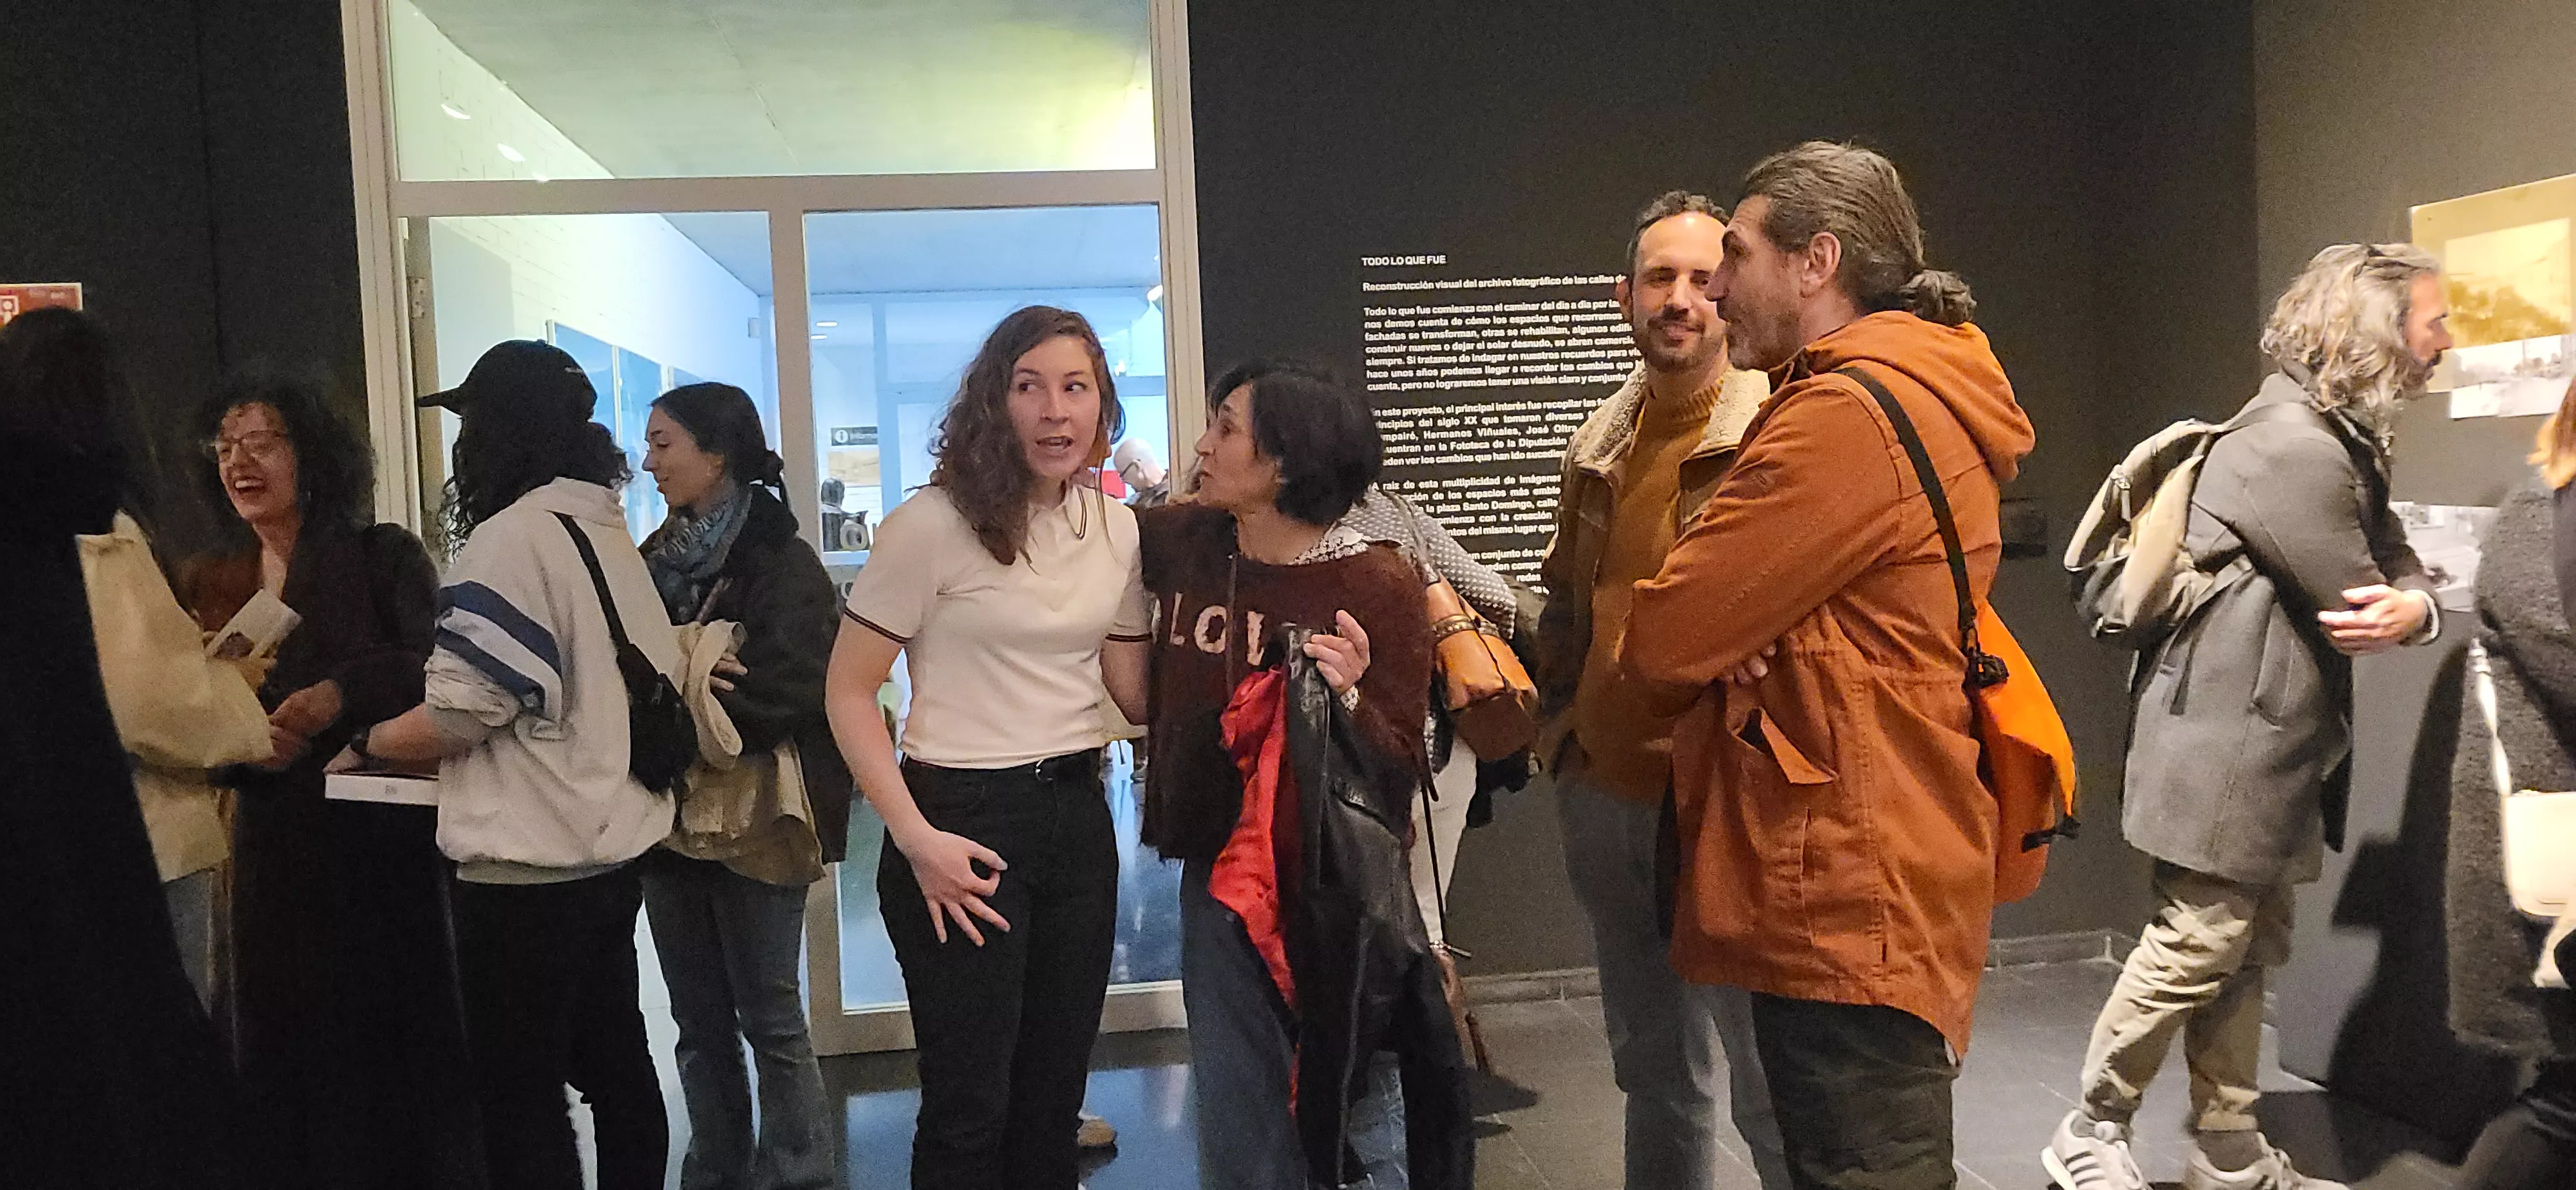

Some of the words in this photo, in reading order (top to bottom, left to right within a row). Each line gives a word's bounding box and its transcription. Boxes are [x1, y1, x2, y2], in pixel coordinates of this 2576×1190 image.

[1361, 257, 1389, 266] TODO
[1405, 256, 1426, 265] QUE
[1426, 255, 1446, 264] FUE
[1363, 281, 1434, 291] Reconstrucción
[1435, 279, 1462, 288] visual
[1463, 279, 1477, 288] del
[1479, 278, 1511, 287] archivo
[1512, 277, 1561, 288] fotográfico
[1562, 276, 1573, 285] de
[1574, 276, 1587, 284] las
[1589, 275, 1615, 283] calles
[1363, 307, 1387, 316] Todo
[1398, 308, 1416, 316] que
[1416, 306, 1431, 314] fue
[1432, 305, 1475, 314] comienza
[1495, 303, 1502, 312] el
[1504, 302, 1540, 311] caminar
[1540, 301, 1555, 310] del
[1593, 301, 1607, 310] por
[1417, 318, 1448, 326] cuenta
[1451, 317, 1463, 325] de
[1465, 316, 1491, 325] cómo
[1493, 316, 1507, 324] los
[1510, 314, 1549, 325] espacios
[1552, 315, 1569, 323] que
[1571, 313, 1623, 322] recorremos
[1365, 332, 1406, 341] fachadas
[1421, 330, 1479, 339] transforman,
[1572, 325, 1608, 335] algunos
[1365, 344, 1407, 353] construir
[1452, 341, 1475, 352] dejar
[1477, 341, 1485, 349] el
[1486, 340, 1510, 349] solar
[1511, 339, 1553, 348] desnudo,
[1567, 337, 1593, 346] abren
[1365, 357, 1405, 367] siempre.
[1406, 355, 1416, 364] Si
[1417, 355, 1457, 364] tratamos
[1459, 354, 1470, 363] de
[1472, 354, 1506, 363] indagar
[1520, 352, 1559, 360] nuestros
[1560, 349, 1605, 359] recuerdos
[1607, 350, 1627, 359] para
[1440, 366, 1482, 377] podemos
[1484, 365, 1510, 375] llegar
[1520, 363, 1558, 372] recordar
[1560, 363, 1575, 371] los
[1577, 361, 1614, 370] cambios
[1616, 362, 1633, 372] que
[1367, 382, 1401, 390] cuenta,
[1401, 382, 1422, 392] pero
[1530, 375, 1557, 384] visión
[1558, 375, 1580, 383] clara
[1580, 376, 1587, 384] y
[1588, 373, 1626, 384] conjunta
[1402, 406, 1444, 417] proyecto,
[1446, 405, 1454, 413] el
[1455, 403, 1494, 414] principal
[1495, 402, 1526, 411] interés
[1527, 401, 1542, 410] fue
[1543, 399, 1582, 410] recopilar
[1583, 399, 1596, 407] las
[1419, 418, 1433, 427] del
[1437, 417, 1460, 428] siglo
[1464, 416, 1477, 424] XX
[1481, 417, 1499, 426] que
[1503, 415, 1541, 423] tomaron
[1546, 412, 1584, 421] diversos
[1423, 430, 1472, 439] Hermanos
[1477, 427, 1521, 437] Viñuales,
[1526, 424, 1549, 434] José
[1439, 442, 1447, 451] la
[1450, 441, 1490, 451] Fototeca
[1492, 440, 1504, 448] de
[1518, 437, 1567, 448] Diputación
[1435, 453, 1473, 463] cambios
[1475, 454, 1492, 463] que
[1493, 452, 1510, 460] han
[1511, 451, 1525, 459] ido
[1403, 480, 1415, 489] de
[1418, 480, 1438, 489] esta
[1442, 476, 1500, 488] multiplicidad
[1504, 476, 1515, 484] de
[1448, 491, 1462, 499] los
[1466, 489, 1506, 500] espacios
[1510, 487, 1530, 496] más
[1426, 504, 1434, 514] la
[1437, 504, 1461, 514] plaza
[1463, 502, 1489, 511] Santo
[1491, 500, 1535, 510] Domingo,
[1513, 511, 1552, 520] creación
[1468, 526, 1482, 535] del
[1482, 526, 1513, 534] mismo
[1514, 524, 1538, 534] lugar
[1481, 549, 1520, 560] conjunto
[1522, 548, 1533, 557] de
